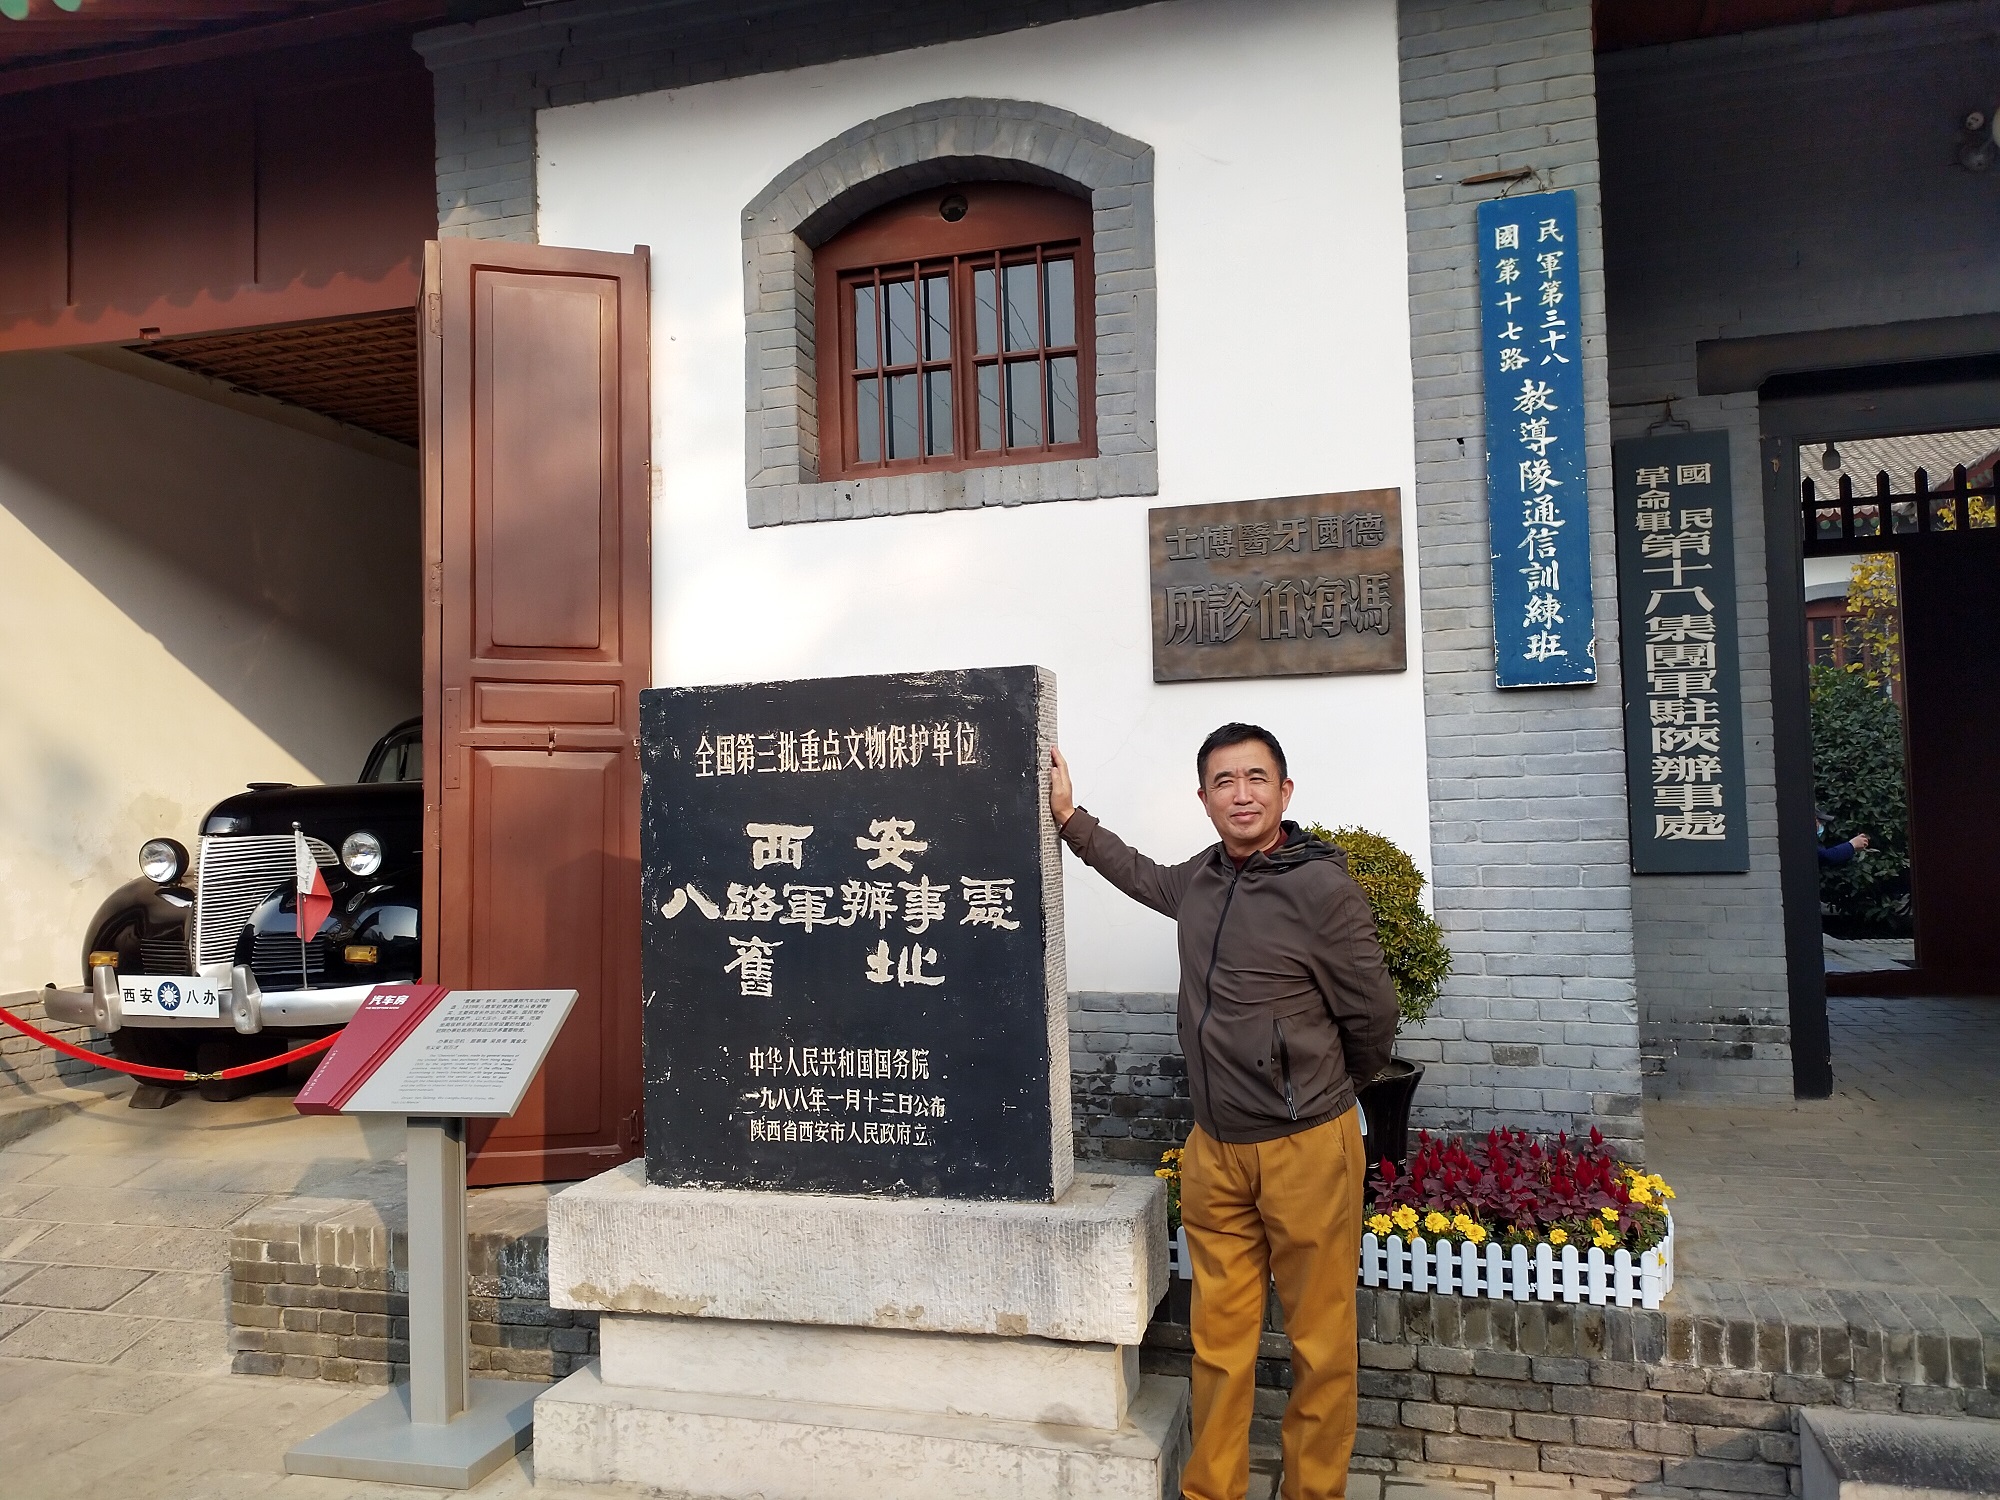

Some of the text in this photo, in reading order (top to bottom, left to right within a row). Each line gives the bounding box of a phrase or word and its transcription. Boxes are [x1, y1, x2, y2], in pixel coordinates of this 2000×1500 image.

[1512, 379, 1567, 662] 教導隊通信訓練班
[695, 721, 977, 777] 全国第三批重点文物保护单位
[122, 988, 216, 1006] 西安 八办
[368, 994, 410, 1005] 汽车房
[748, 1046, 930, 1080] 中华人民共和国国务院
[744, 1086, 946, 1118] 一九八八年一月十三日公布
[750, 1120, 930, 1146] 陕西省西安市人民政府立
